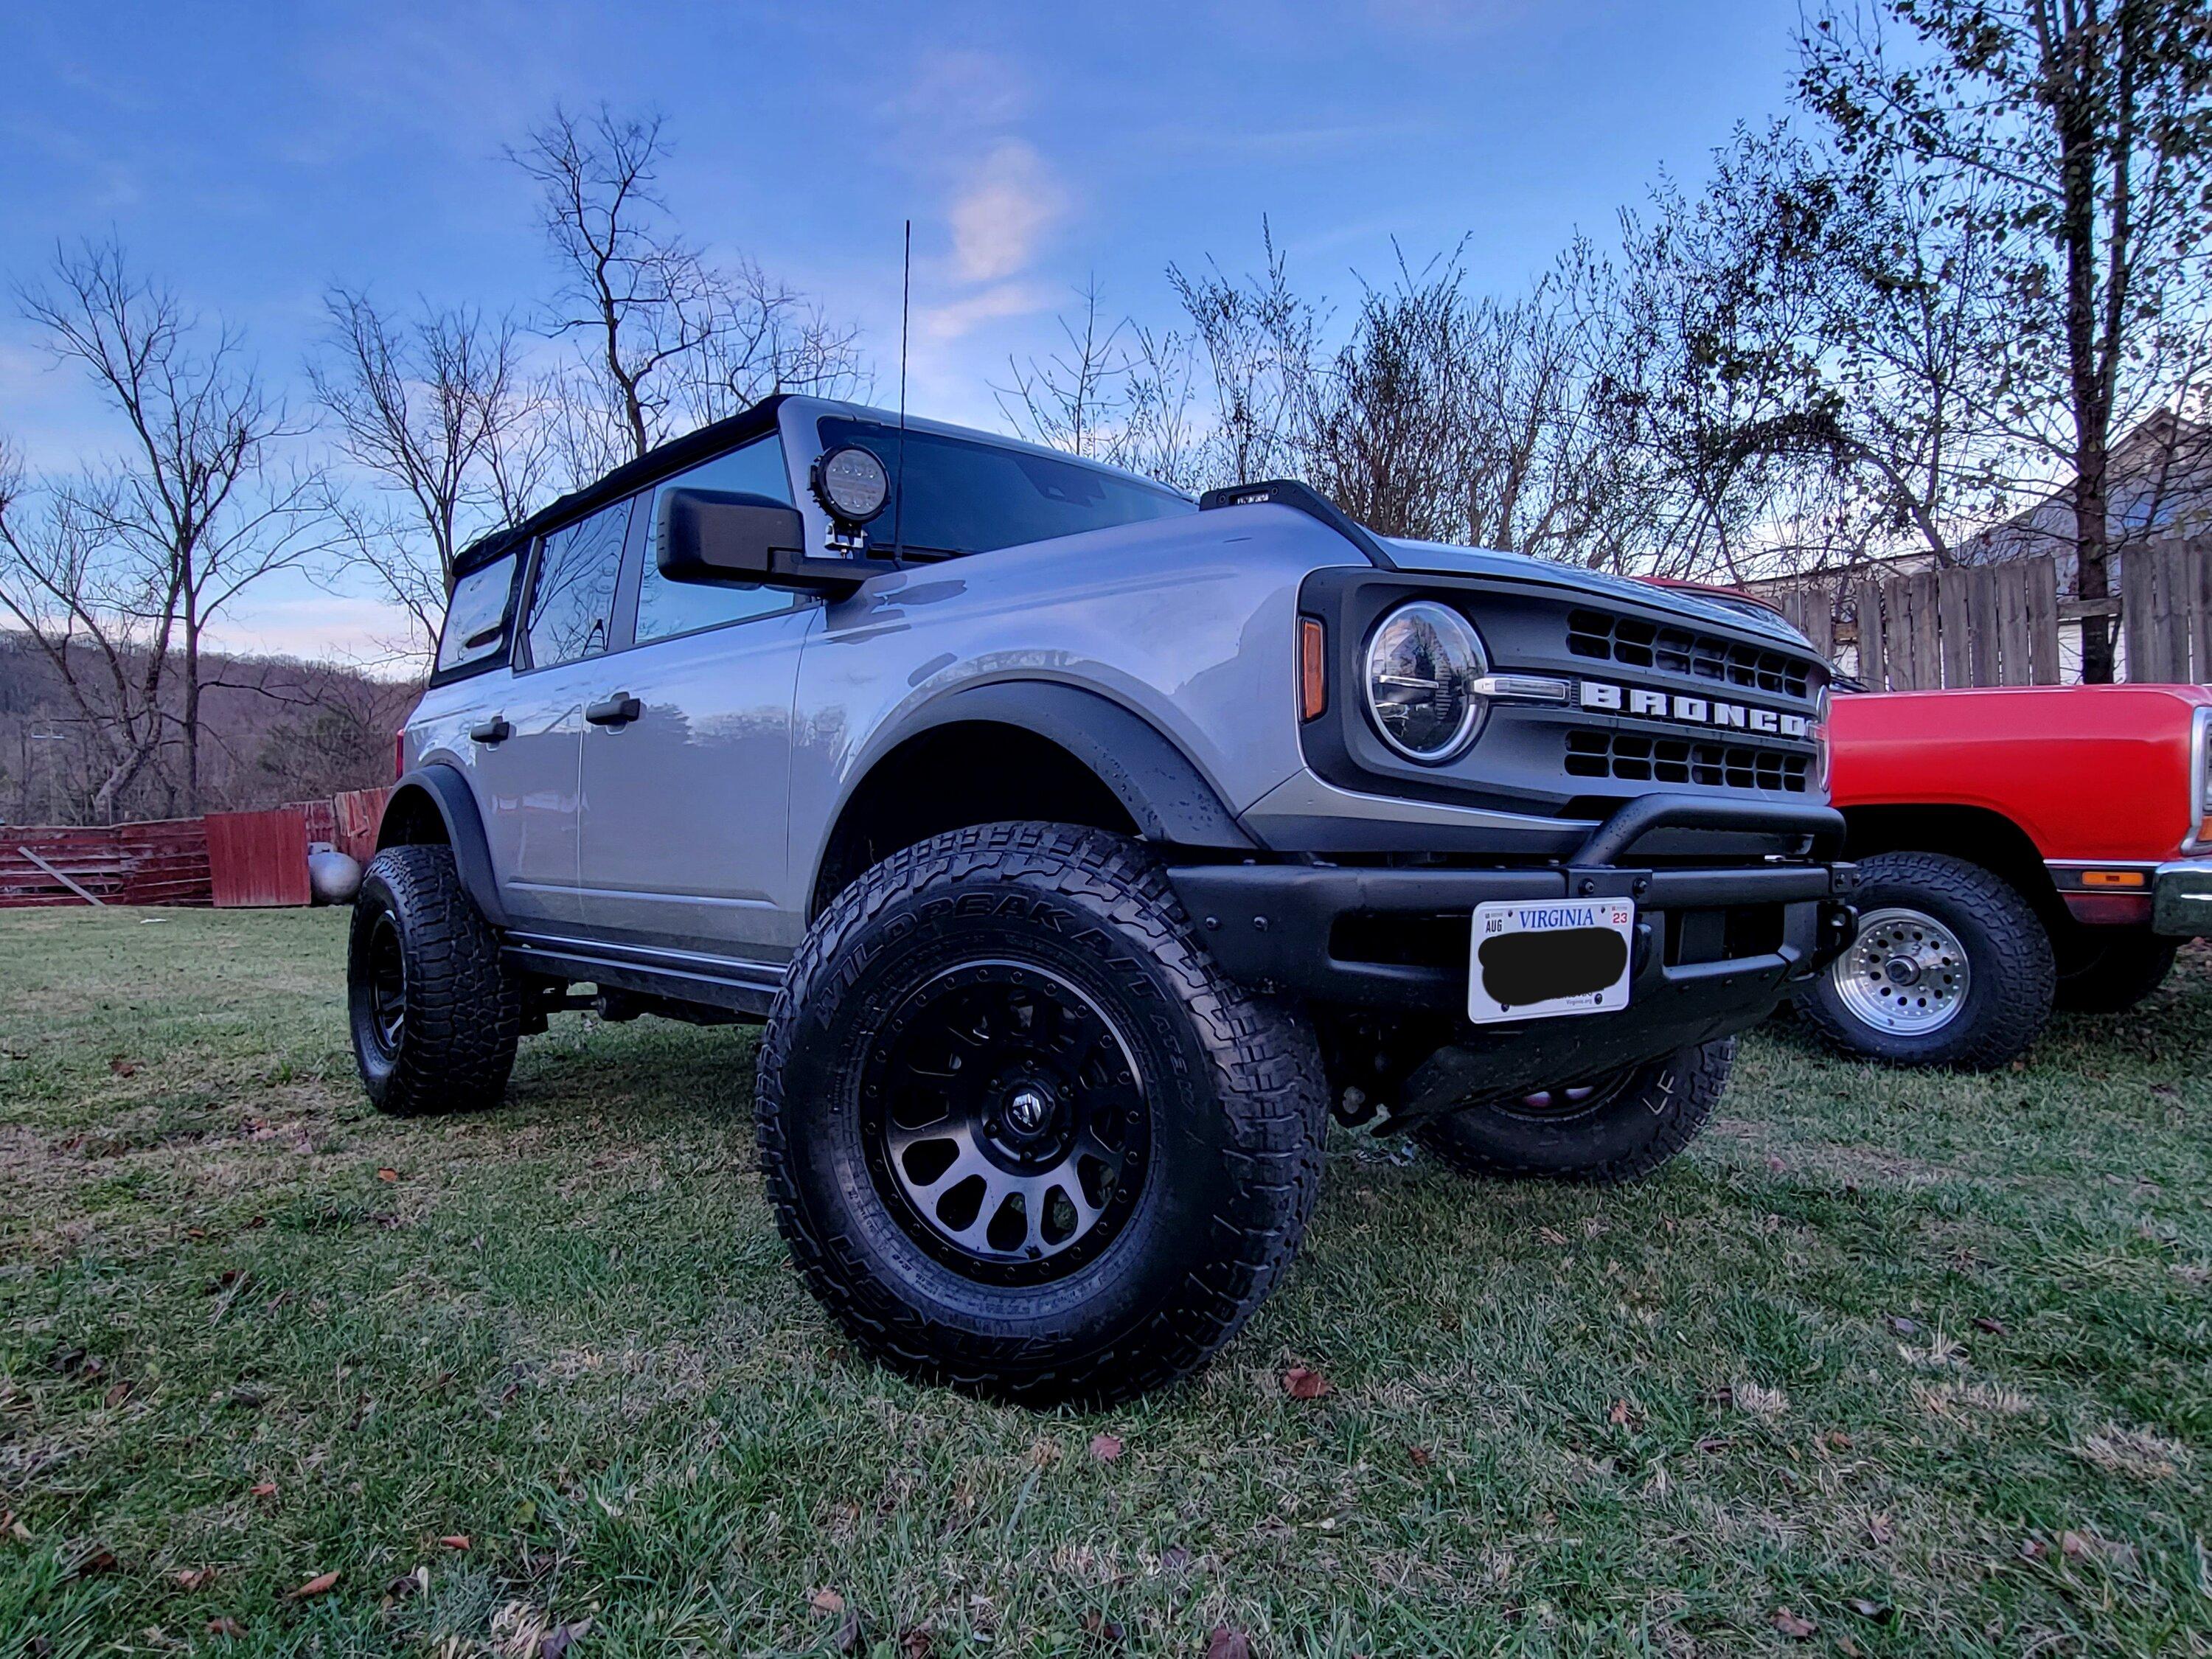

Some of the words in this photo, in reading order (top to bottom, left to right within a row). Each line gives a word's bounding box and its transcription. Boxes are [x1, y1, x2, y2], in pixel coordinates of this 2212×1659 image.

[1580, 681, 1806, 737] BRONCO
[1485, 919, 1503, 933] AUG
[1519, 908, 1594, 928] VIRGINIA
[1613, 912, 1628, 924] 23
[814, 891, 1076, 1031] WILDPEAK
